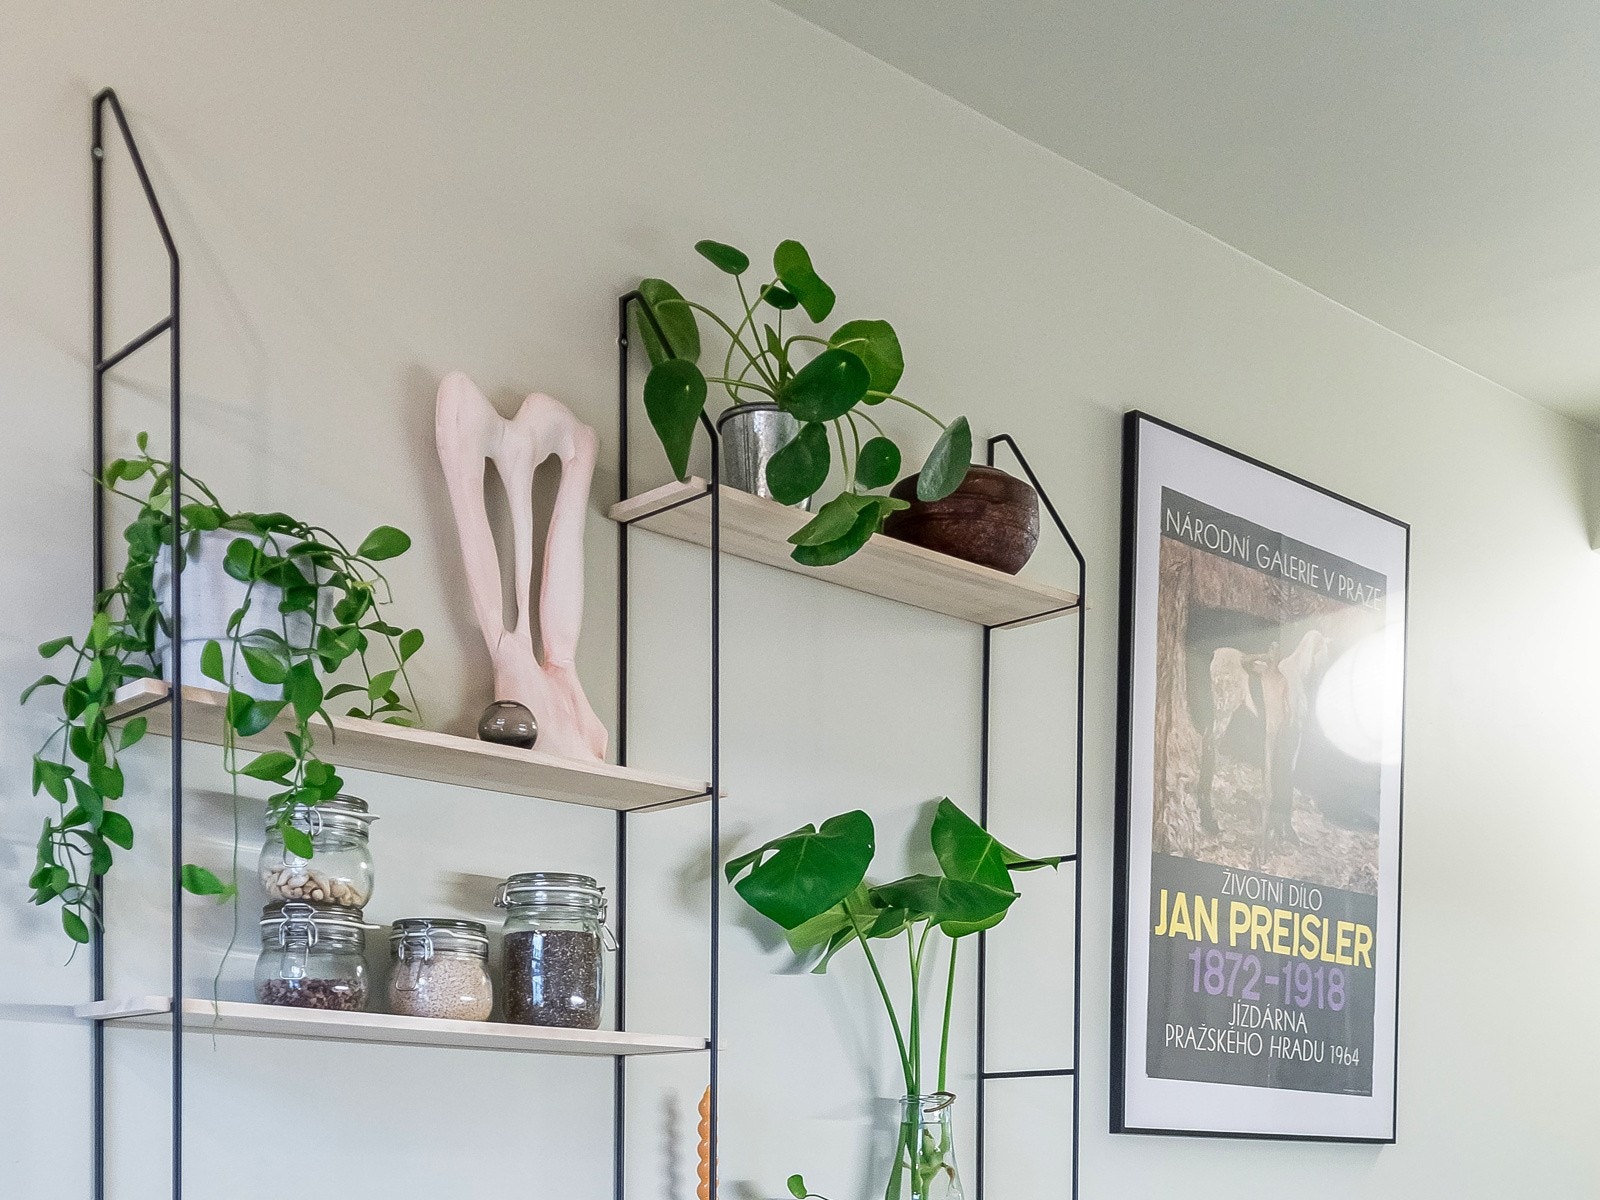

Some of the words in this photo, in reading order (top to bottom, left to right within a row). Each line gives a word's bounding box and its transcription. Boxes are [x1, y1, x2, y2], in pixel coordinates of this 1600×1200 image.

[1165, 507, 1250, 563] NÁRODNÍ
[1255, 544, 1320, 589] GALERIE
[1323, 568, 1335, 592] V
[1338, 573, 1382, 611] PRAZE
[1221, 868, 1284, 905] ŽIVOTNÍ
[1288, 883, 1323, 911] DÍLO
[1154, 888, 1219, 945] JAN
[1229, 901, 1374, 969] PREISLER
[1188, 946, 1346, 1012] 1872-1918
[1227, 999, 1309, 1035] JÍZDÁRNA
[1164, 1023, 1263, 1057] PRAŽSKÉHO
[1269, 1035, 1325, 1064] HRADU
[1329, 1045, 1360, 1067] 1964
